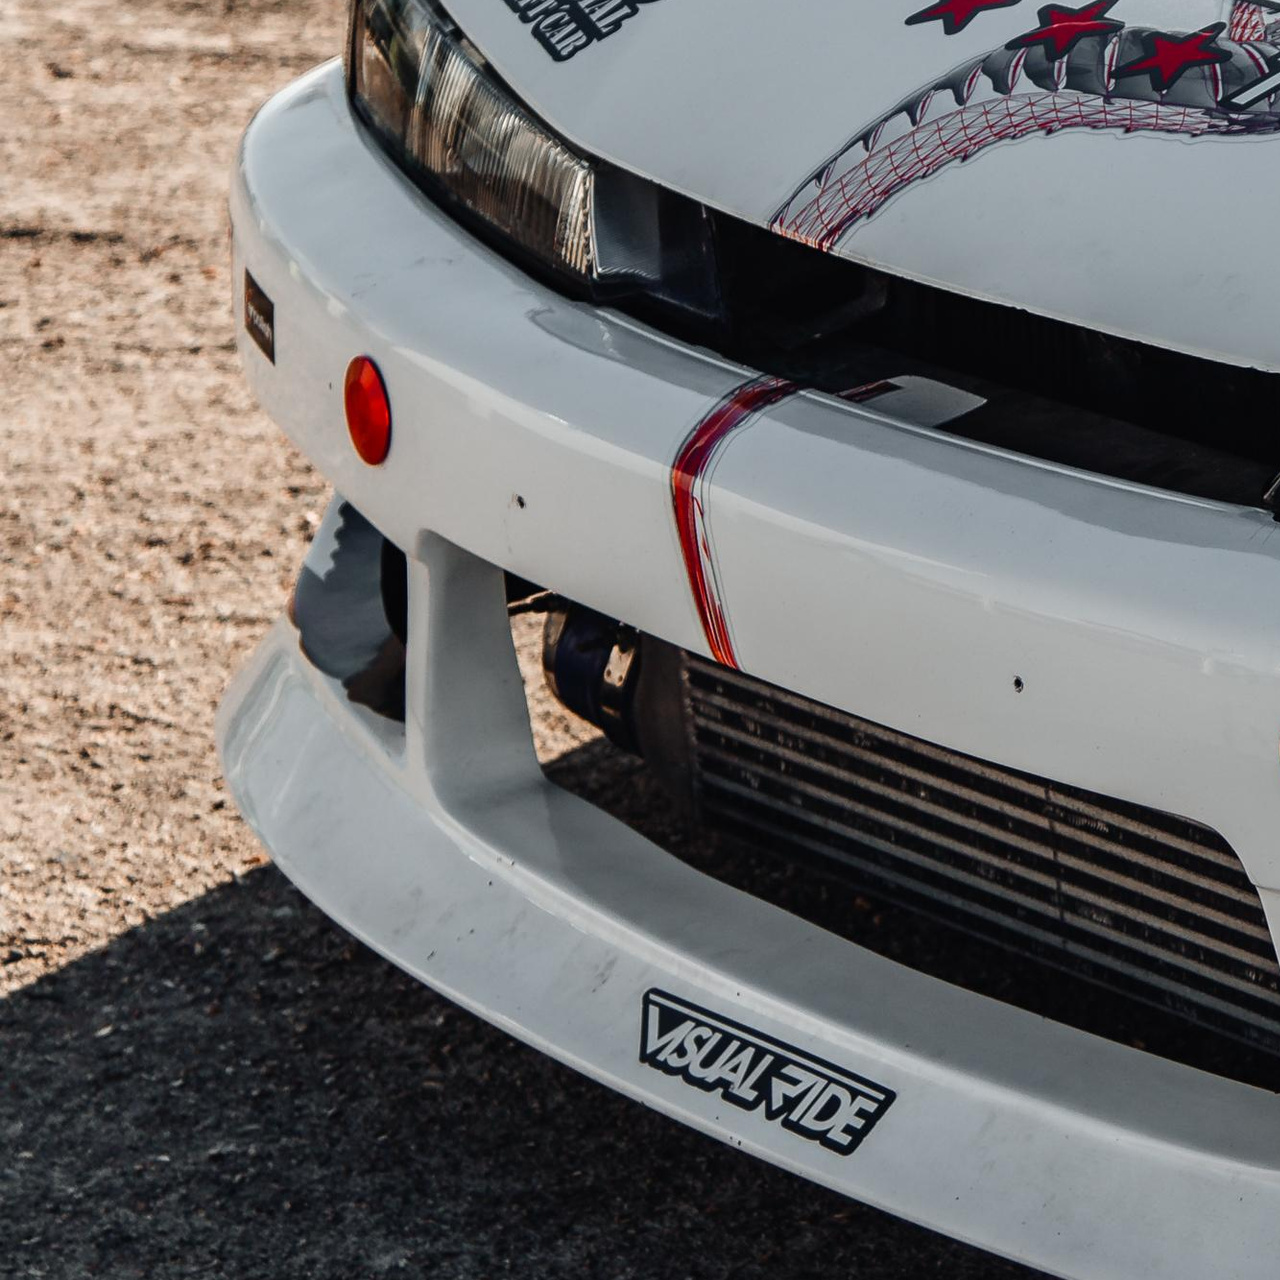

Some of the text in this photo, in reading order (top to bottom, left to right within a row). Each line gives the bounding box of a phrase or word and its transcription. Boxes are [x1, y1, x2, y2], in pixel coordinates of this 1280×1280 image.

[537, 9, 591, 57] CAR
[646, 1003, 880, 1147] VISUAL RIDE
